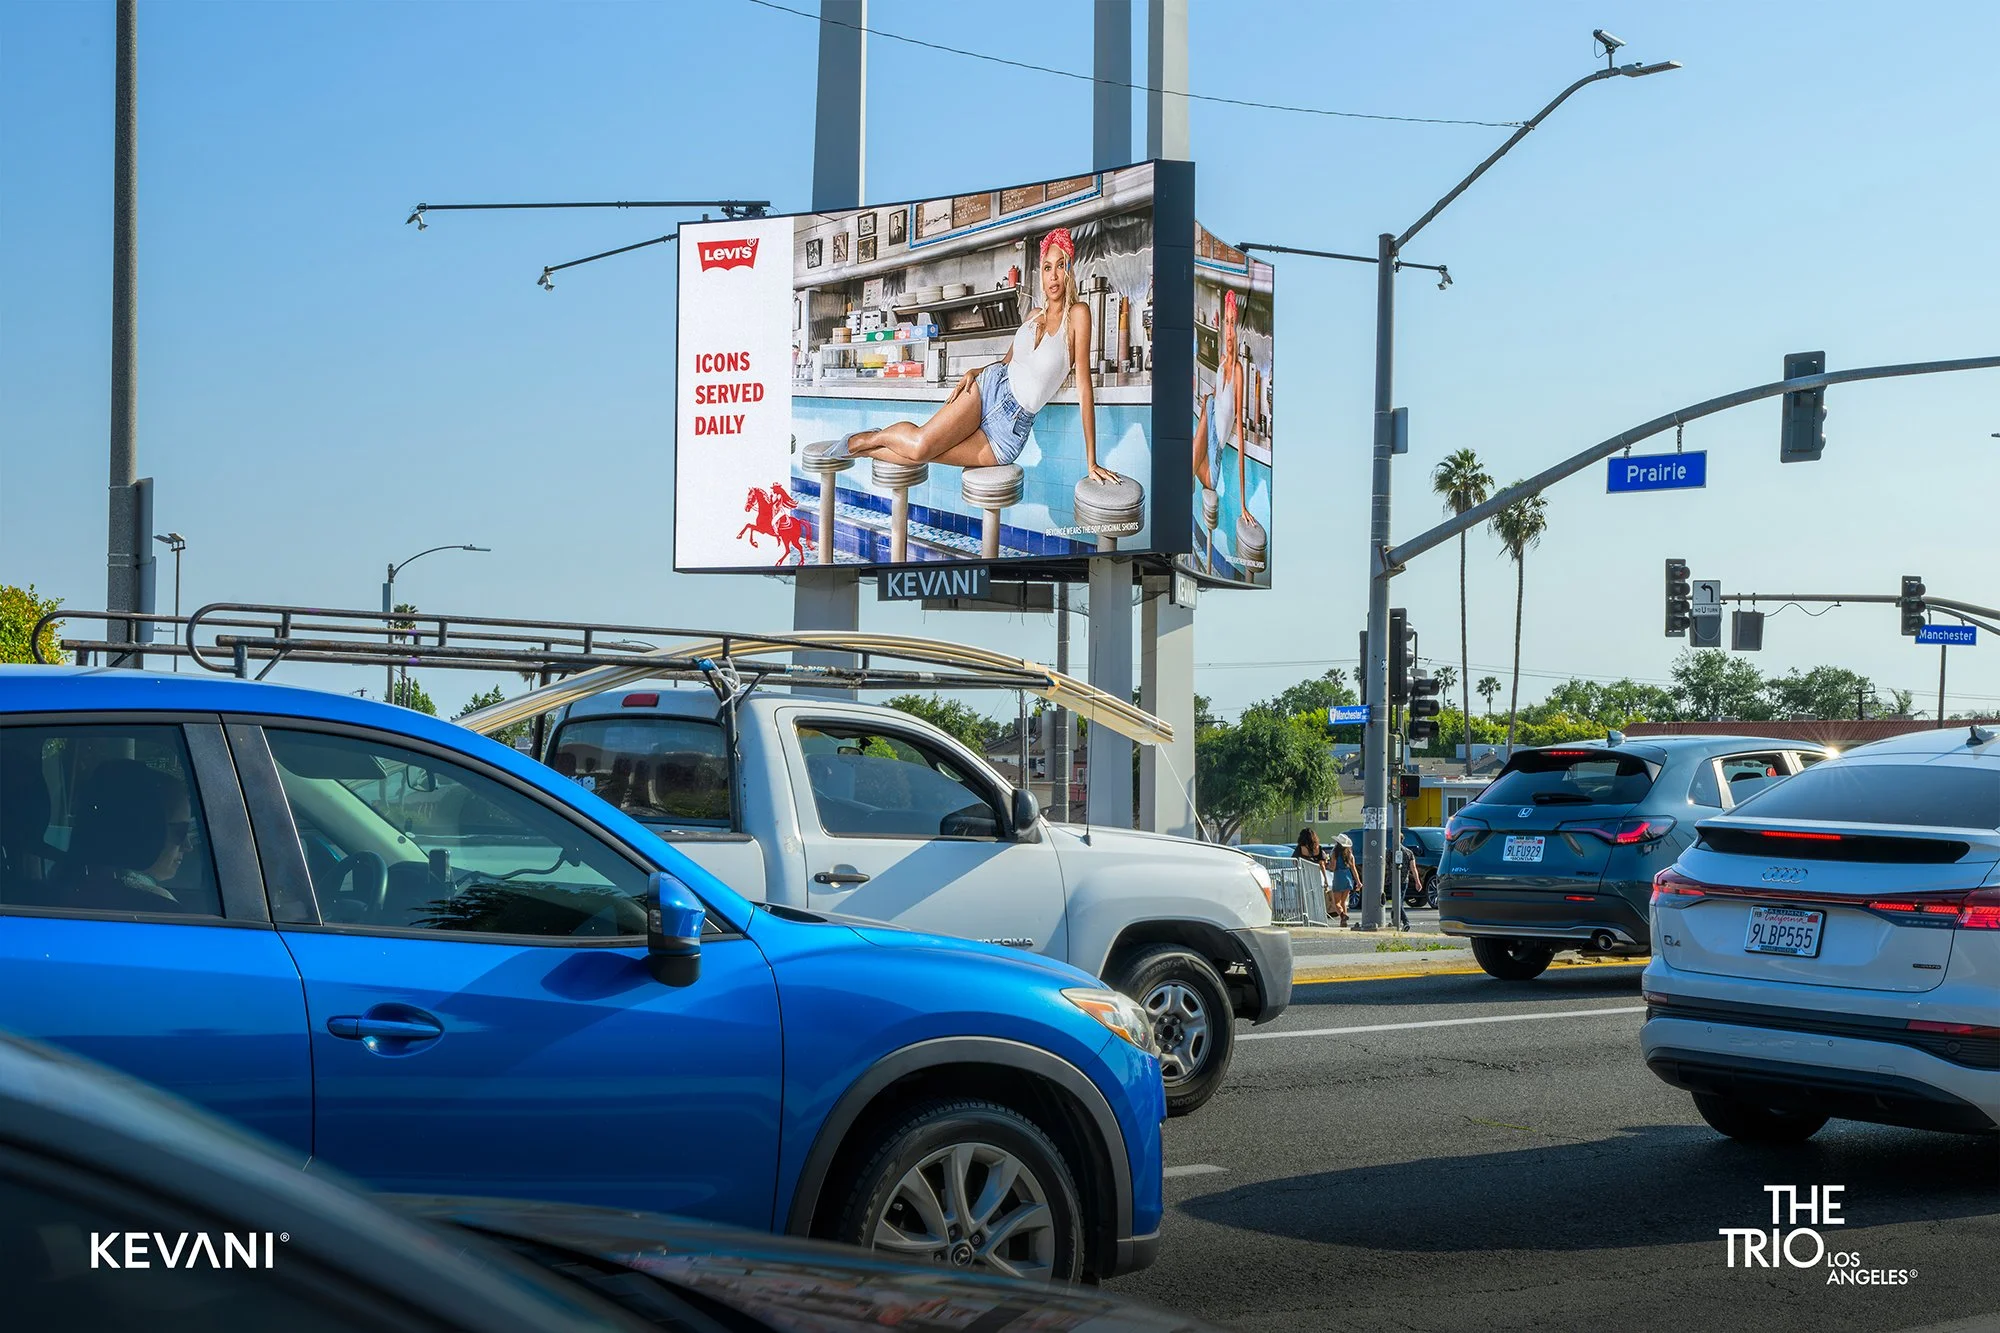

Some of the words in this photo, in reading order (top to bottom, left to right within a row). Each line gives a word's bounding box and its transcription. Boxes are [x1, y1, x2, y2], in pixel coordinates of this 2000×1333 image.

[696, 351, 750, 373] ICONS
[695, 383, 764, 404] SERVED
[695, 414, 745, 436] DAILY
[1627, 462, 1686, 483] Prairie
[1919, 629, 1973, 641] Manchester
[1750, 923, 1814, 949] 9LBP555
